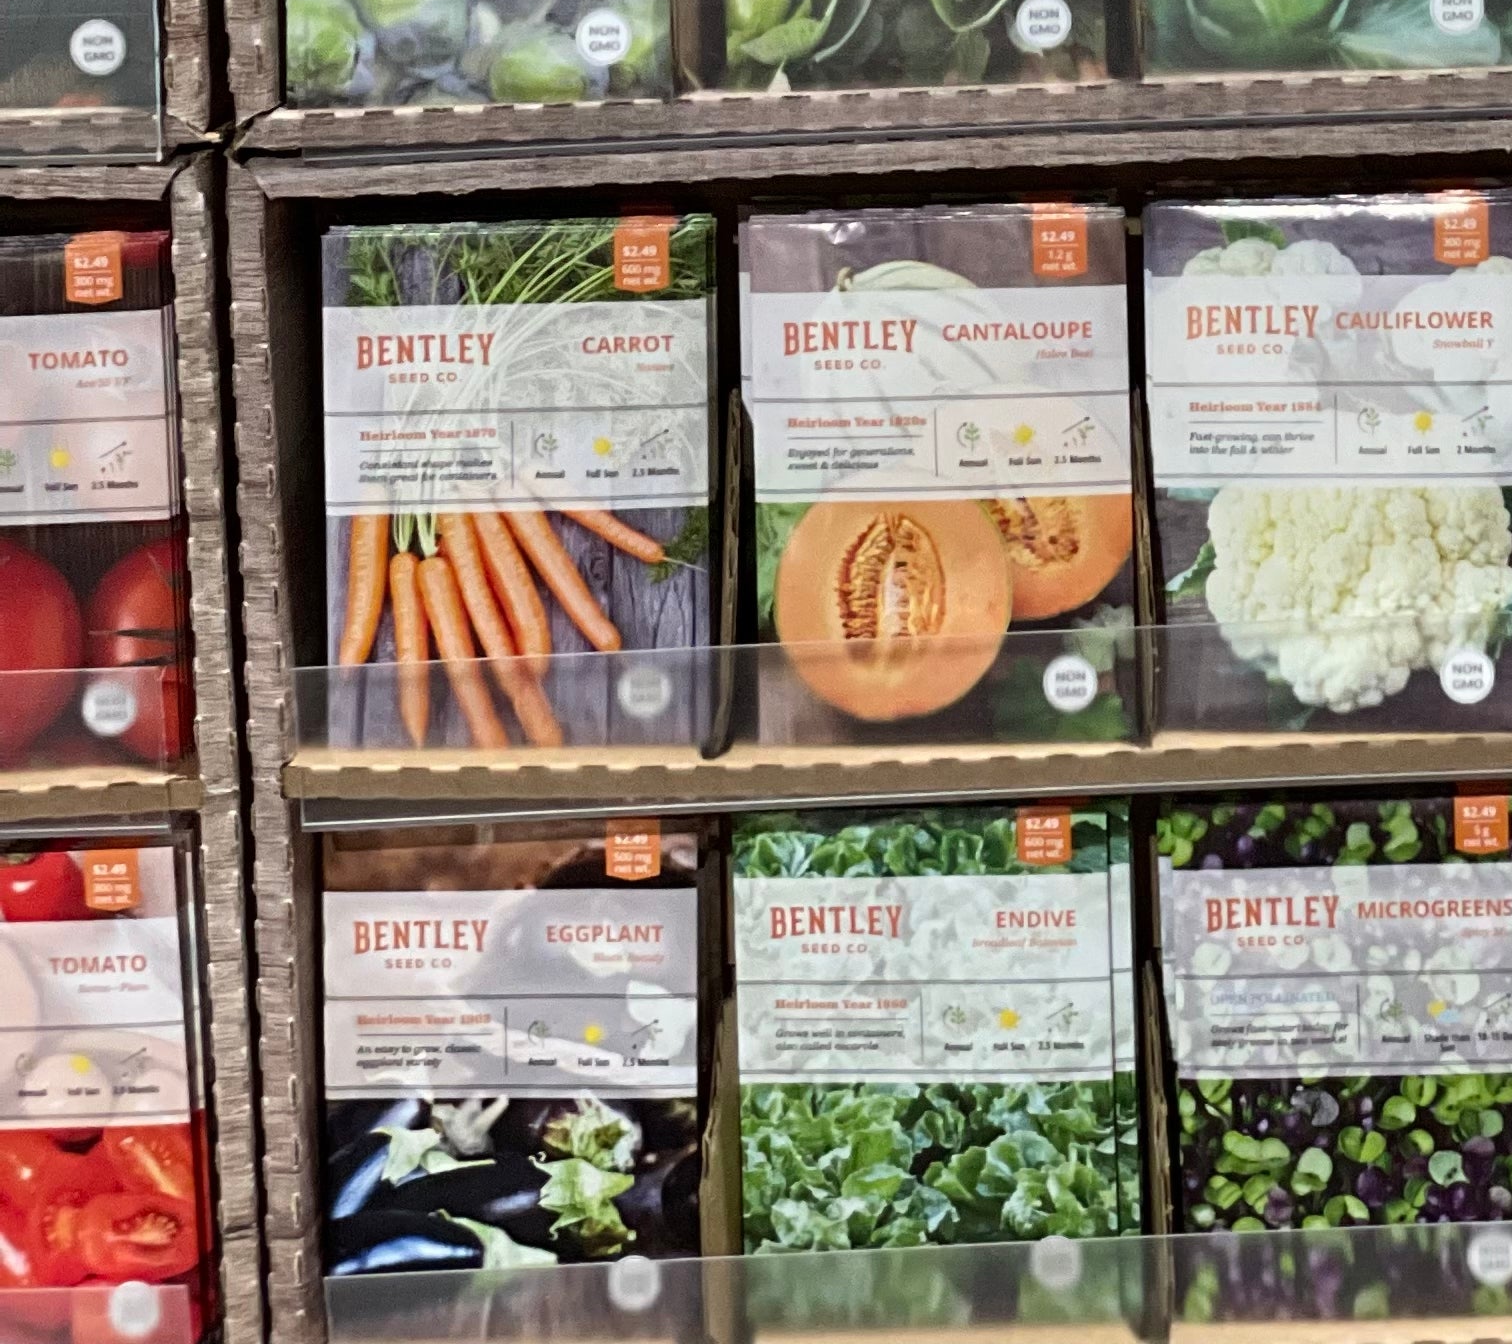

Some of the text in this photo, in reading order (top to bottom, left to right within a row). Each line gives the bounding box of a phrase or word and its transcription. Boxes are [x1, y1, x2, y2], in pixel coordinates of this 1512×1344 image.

[1041, 231, 1075, 242] $2.49
[623, 246, 657, 257] $2.49
[74, 256, 108, 268] $2.49
[1187, 305, 1318, 340] BENTLEY
[1335, 308, 1493, 331] CAULIFLOWER
[784, 319, 917, 356] BENTLEY
[942, 321, 1092, 342] CANTALOUPE
[357, 333, 494, 370] BENTLEY
[582, 335, 673, 354] CARROT
[1217, 343, 1257, 355] SEED
[28, 350, 128, 370] TOMATO
[815, 360, 854, 370] SEED
[388, 372, 430, 383] SEED
[1463, 807, 1496, 818] $2.49
[1026, 818, 1059, 830] $2.49
[93, 864, 126, 875] $2.49
[1206, 896, 1338, 933] BENTLEY
[1358, 899, 1512, 918] MICROGREENS
[771, 906, 902, 939] BENTLEY
[996, 910, 1075, 928] ENDIVE
[354, 920, 488, 955] BENTLEY
[546, 924, 664, 943] EGGPLANT
[1237, 935, 1277, 947] SEED
[47, 955, 147, 974] TOMATO
